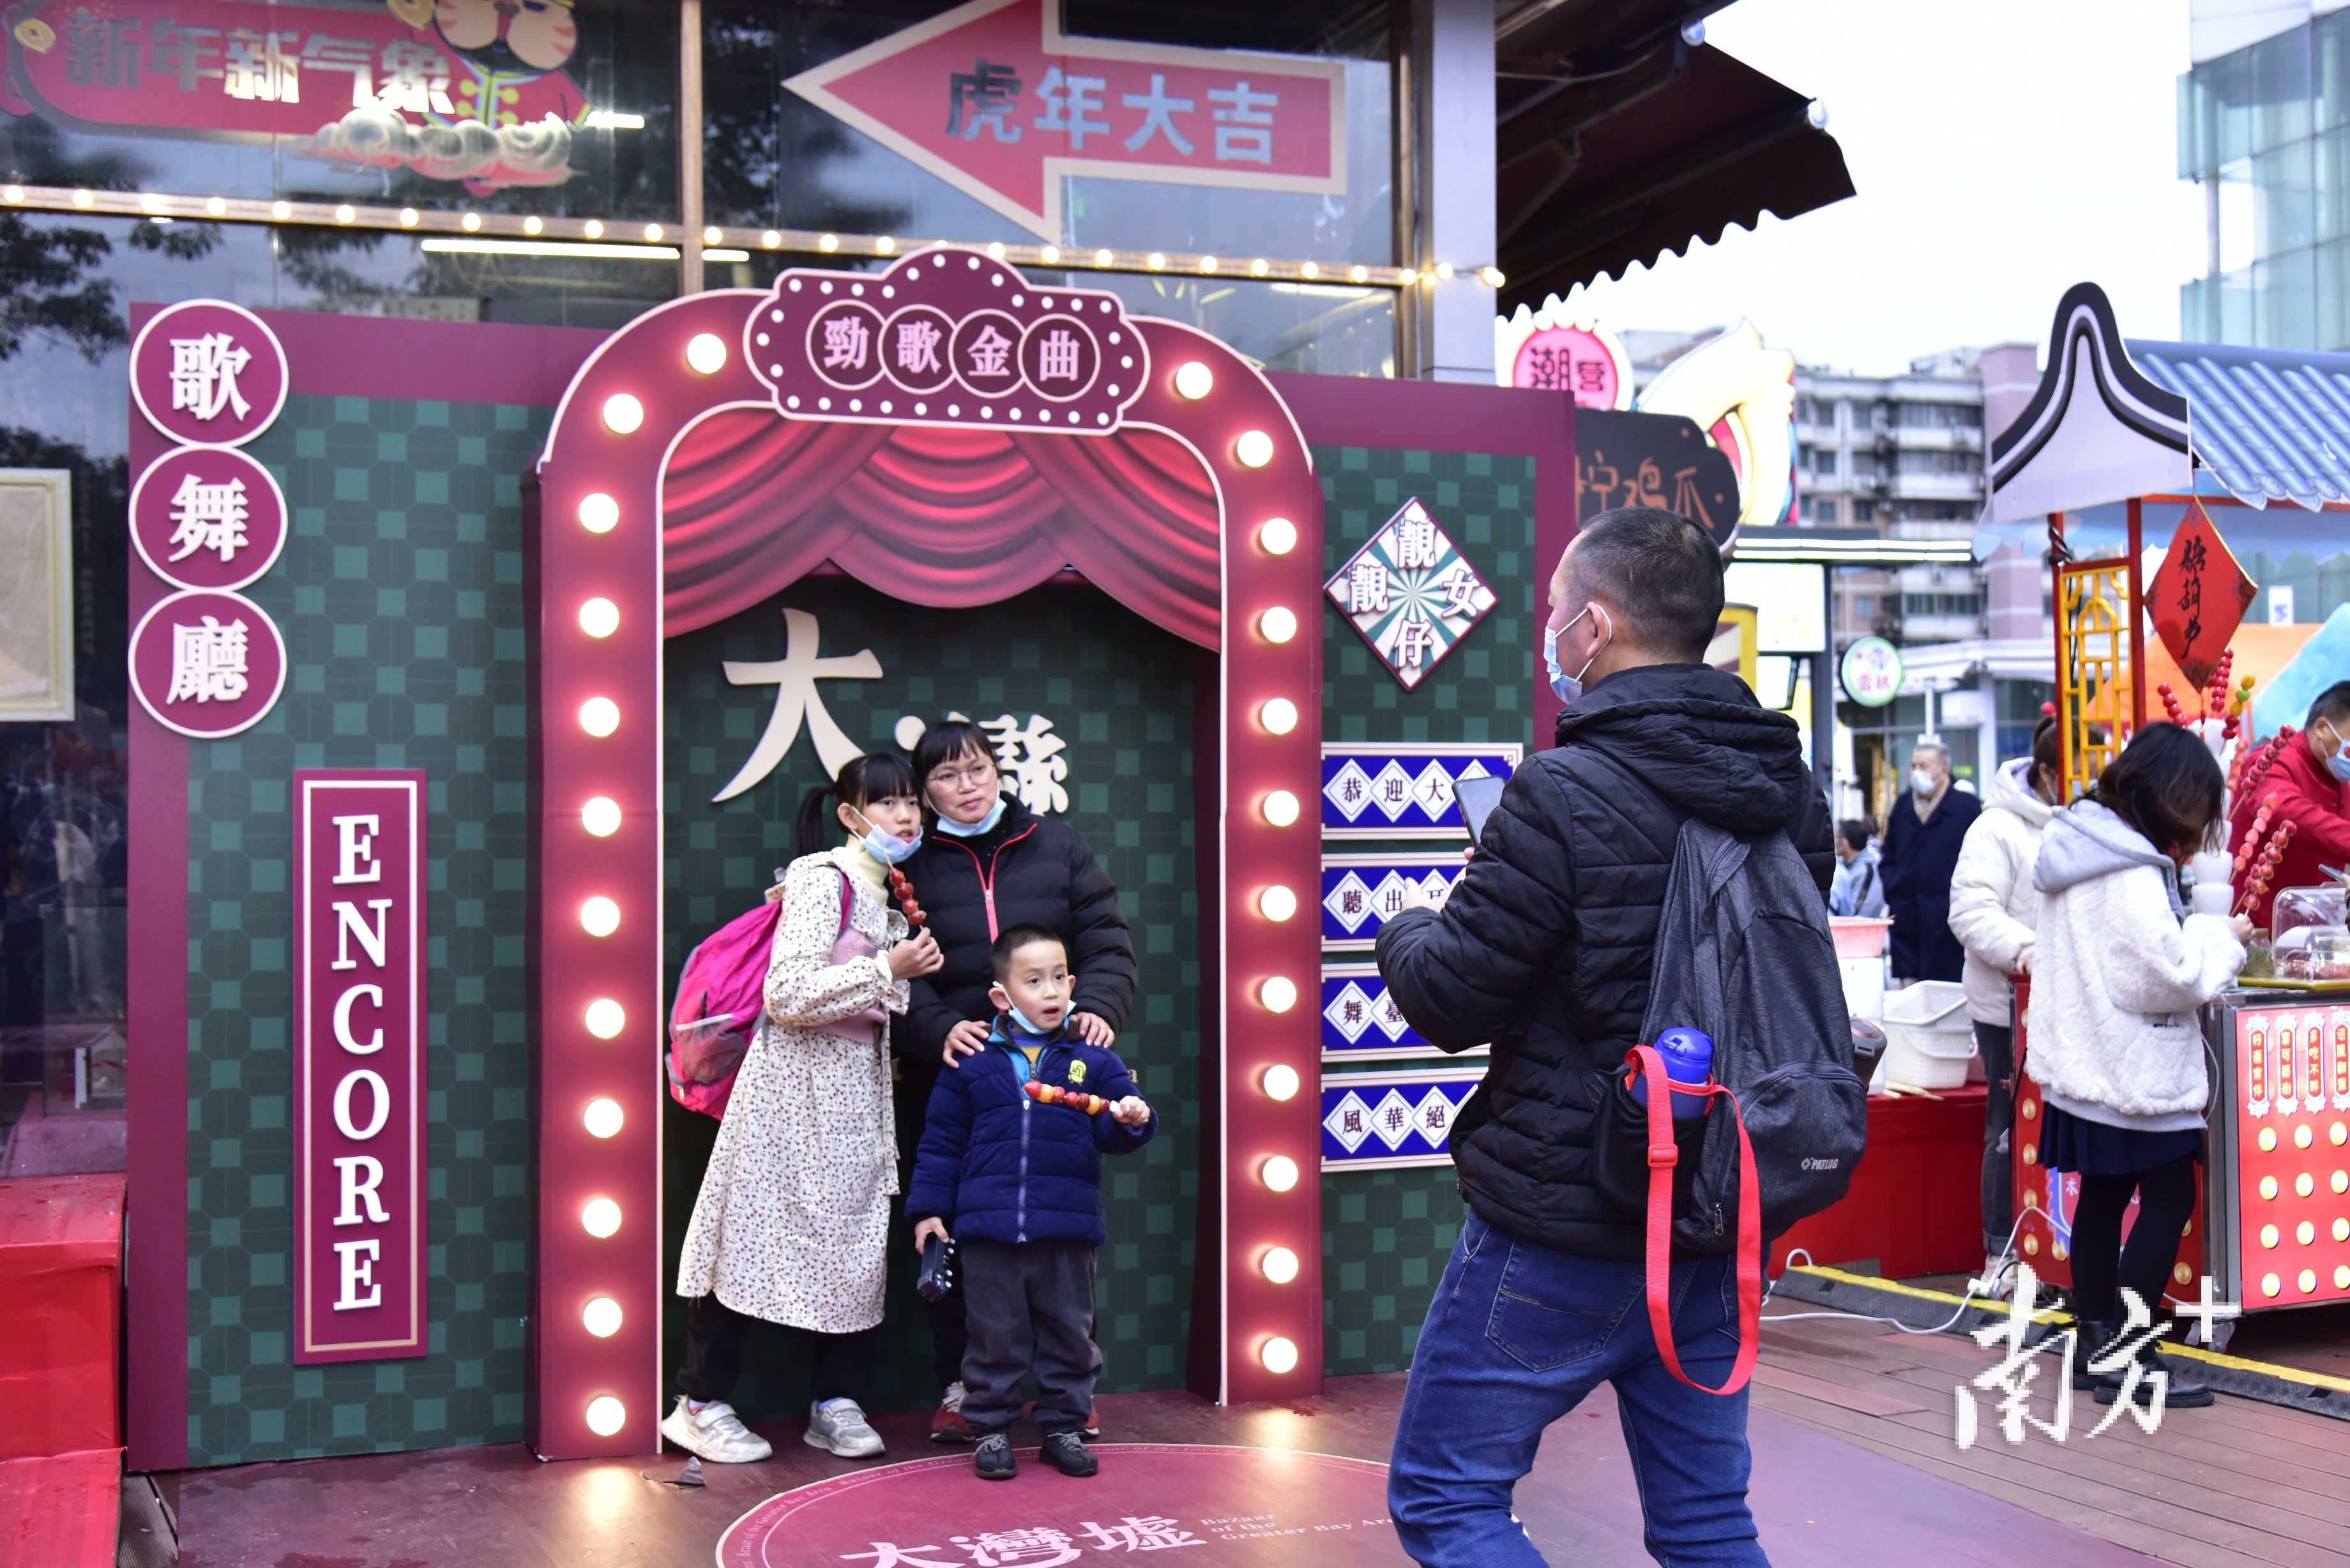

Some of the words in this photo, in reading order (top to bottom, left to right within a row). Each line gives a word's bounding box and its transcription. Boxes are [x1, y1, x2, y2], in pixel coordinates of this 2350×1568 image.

[64, 9, 457, 114] 新年新气象
[945, 57, 1278, 165] 虎年大吉
[823, 316, 1080, 382] 勁歌金曲
[167, 332, 252, 705] 歌舞廳
[331, 813, 393, 1312] ENCORE
[2308, 1029, 2319, 1093] 多吃不胖
[1200, 1512, 1277, 1525] Bazaar
[1211, 1524, 1232, 1533] of
[1239, 1520, 1277, 1530] the
[1220, 1526, 1307, 1540] Greater
[1313, 1521, 1353, 1532] Bay
